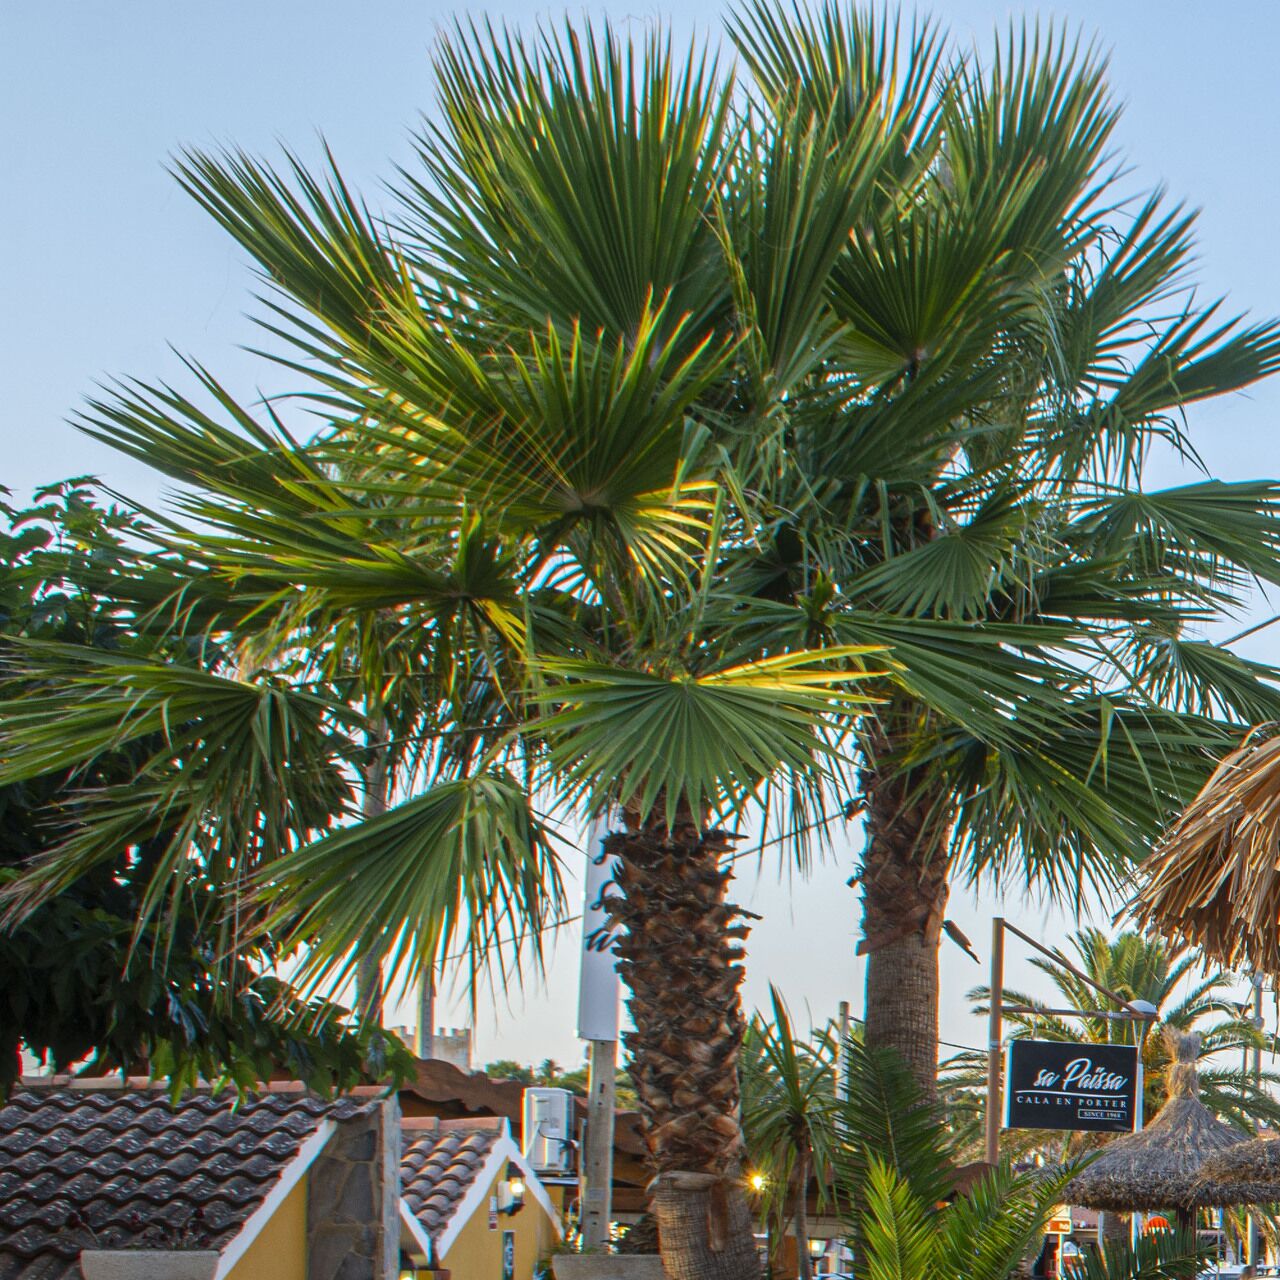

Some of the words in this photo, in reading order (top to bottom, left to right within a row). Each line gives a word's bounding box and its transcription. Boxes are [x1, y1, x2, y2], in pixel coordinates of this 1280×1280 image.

[1033, 1069, 1060, 1087] sa
[1062, 1058, 1128, 1090] Païssa
[1017, 1096, 1050, 1105] CALA
[1056, 1097, 1071, 1105] EN
[1078, 1098, 1127, 1108] PORTER
